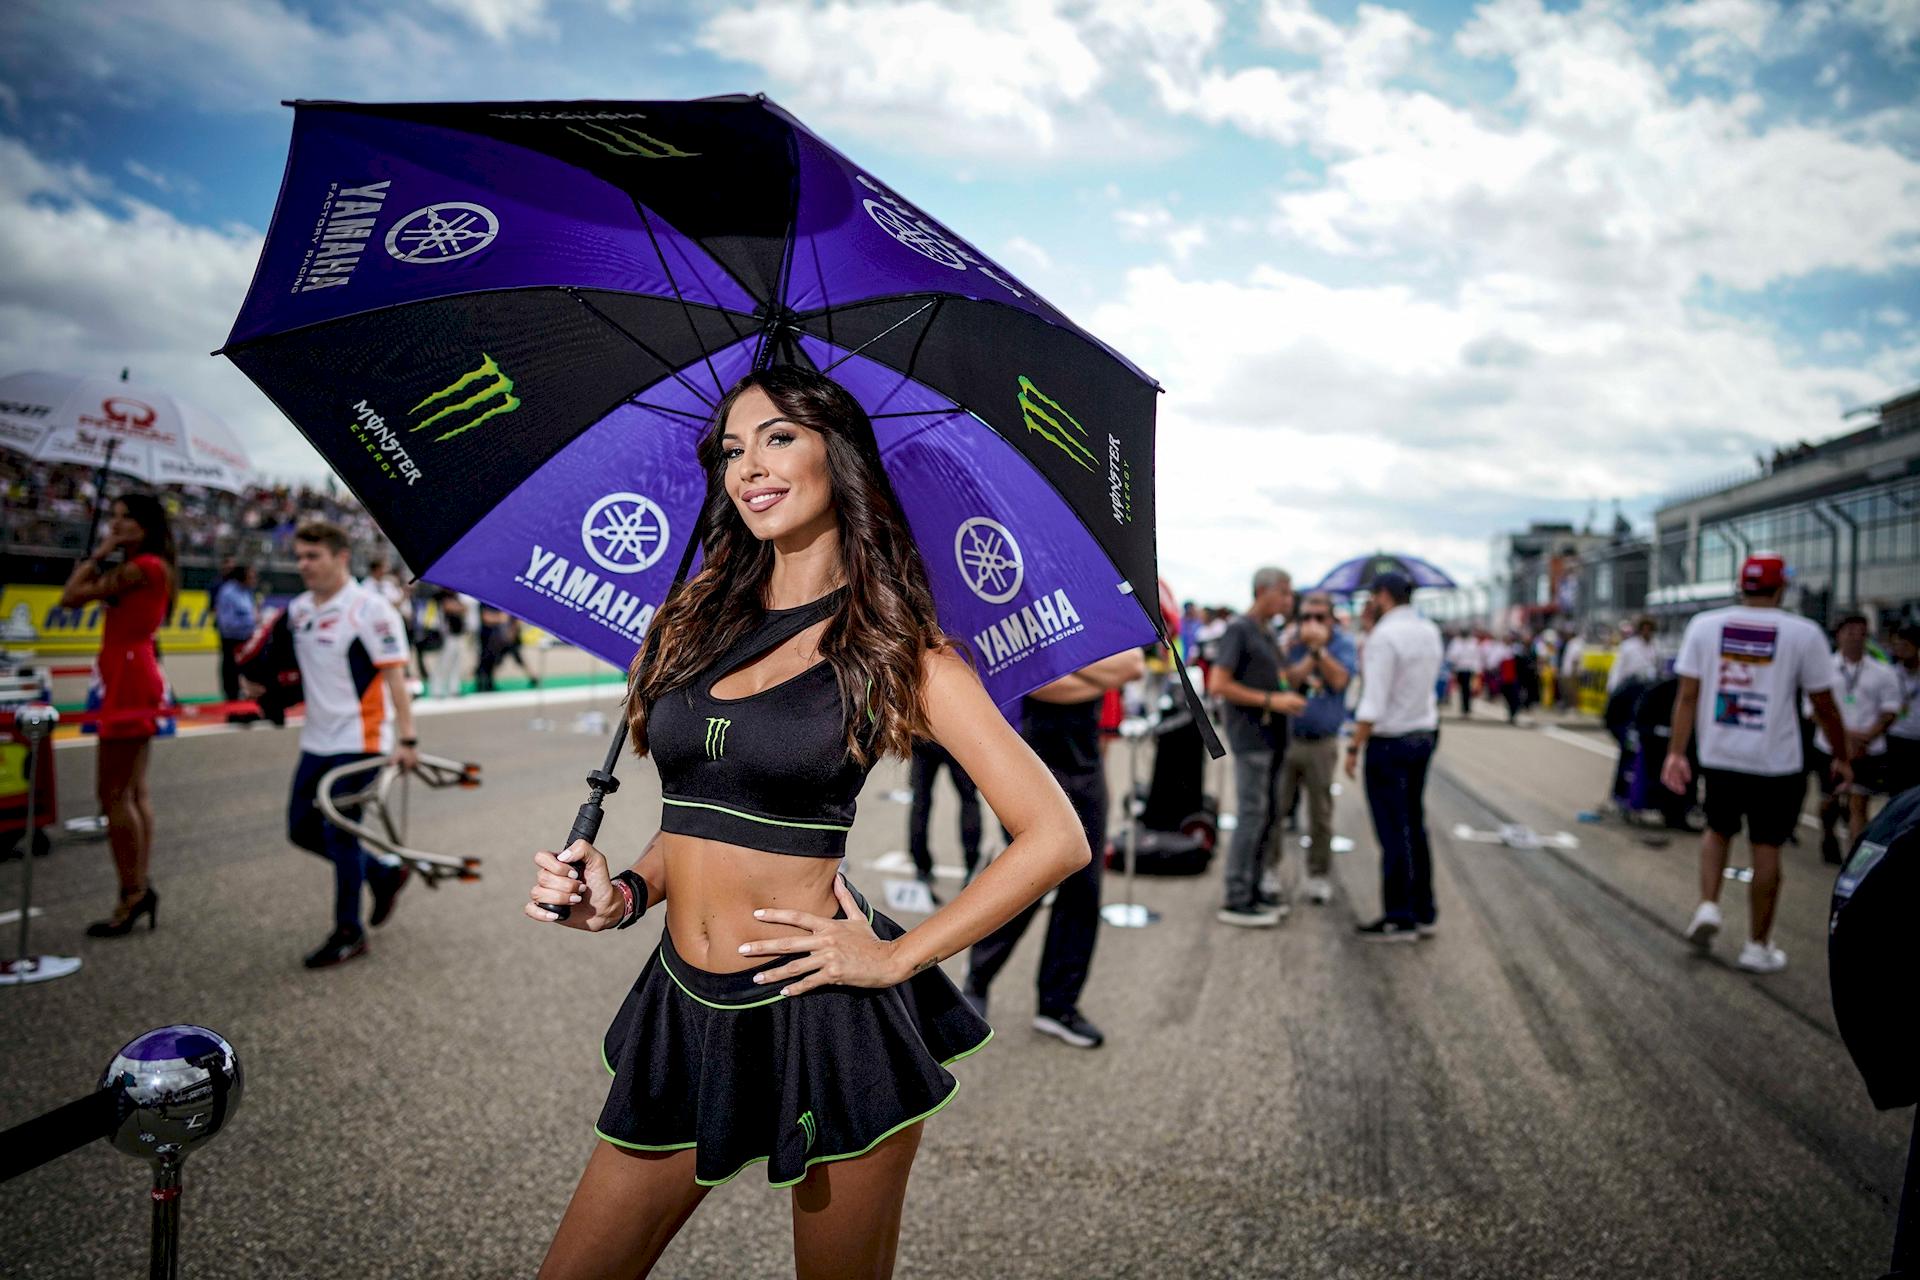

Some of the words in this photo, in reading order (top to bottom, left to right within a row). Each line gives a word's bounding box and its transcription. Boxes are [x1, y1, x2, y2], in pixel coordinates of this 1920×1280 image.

[301, 180, 391, 292] YAMAHA
[312, 183, 338, 244] FACTORY
[291, 249, 314, 294] RACING
[350, 423, 398, 479] ENERGY
[1123, 459, 1132, 522] ENERGY
[514, 575, 585, 613] FACTORY
[589, 612, 642, 645] RACING
[525, 544, 656, 639] YAMAHA
[974, 588, 1081, 667] YAMAHA
[988, 647, 1036, 677] FACTORY
[1040, 623, 1085, 648] RACING
